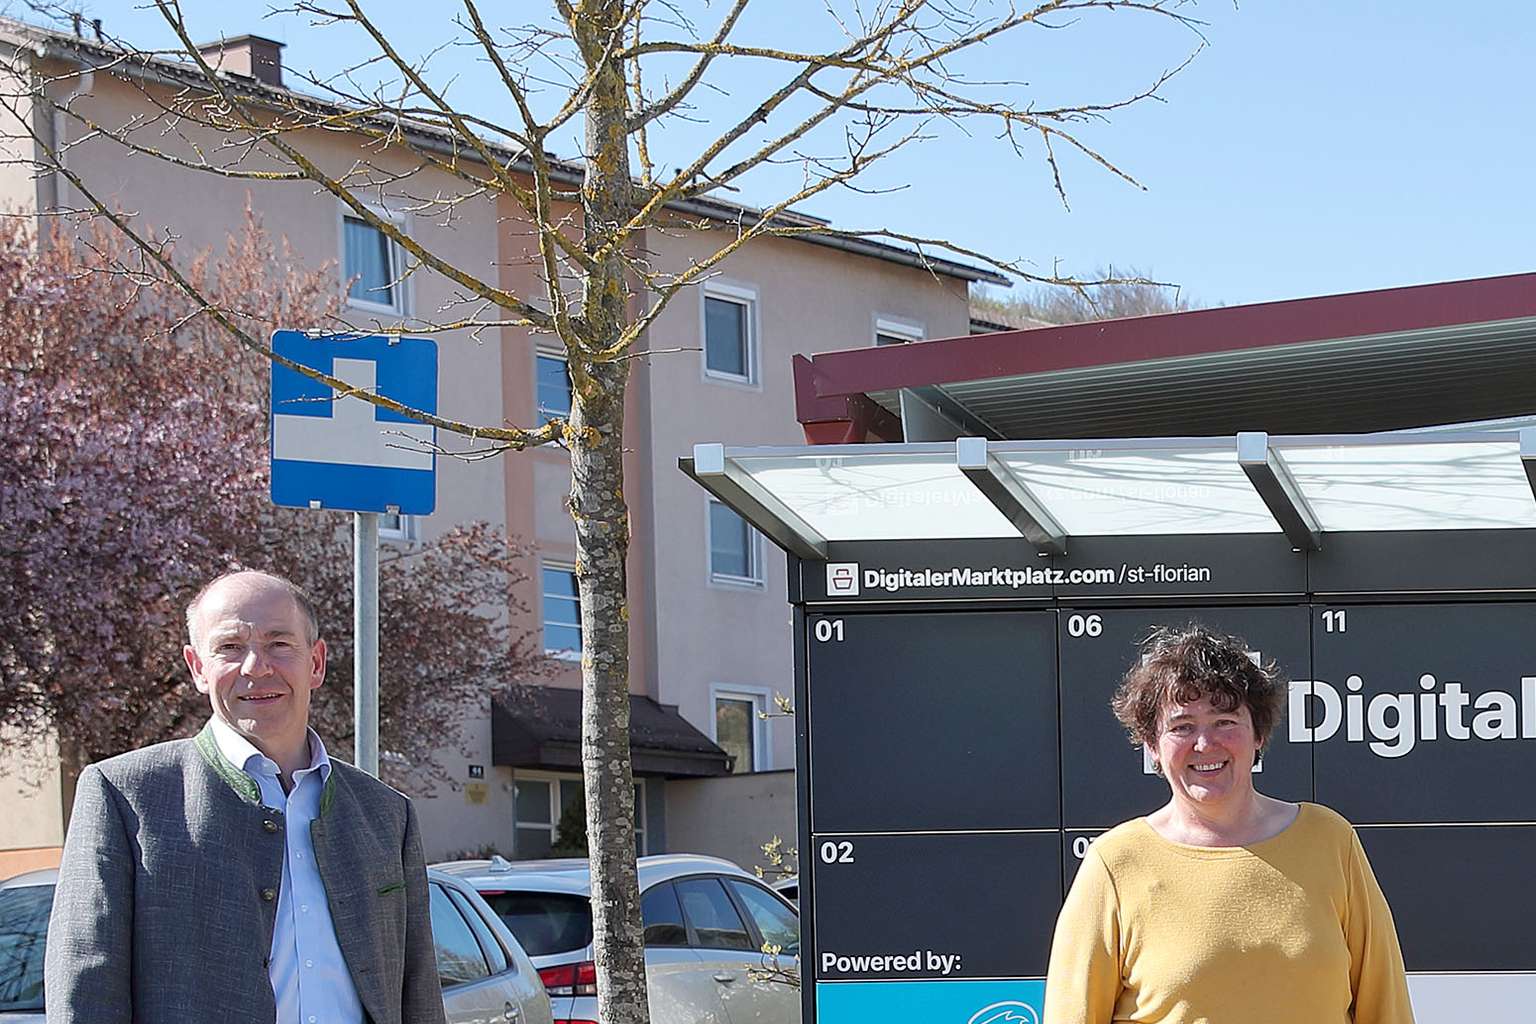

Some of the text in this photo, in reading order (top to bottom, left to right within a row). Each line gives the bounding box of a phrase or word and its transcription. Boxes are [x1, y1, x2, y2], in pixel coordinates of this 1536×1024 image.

[815, 619, 844, 642] 01
[1068, 614, 1102, 637] 06
[1321, 610, 1346, 632] 11
[820, 841, 854, 864] 02
[1072, 836, 1096, 859] 0
[821, 950, 961, 974] Powered by:
